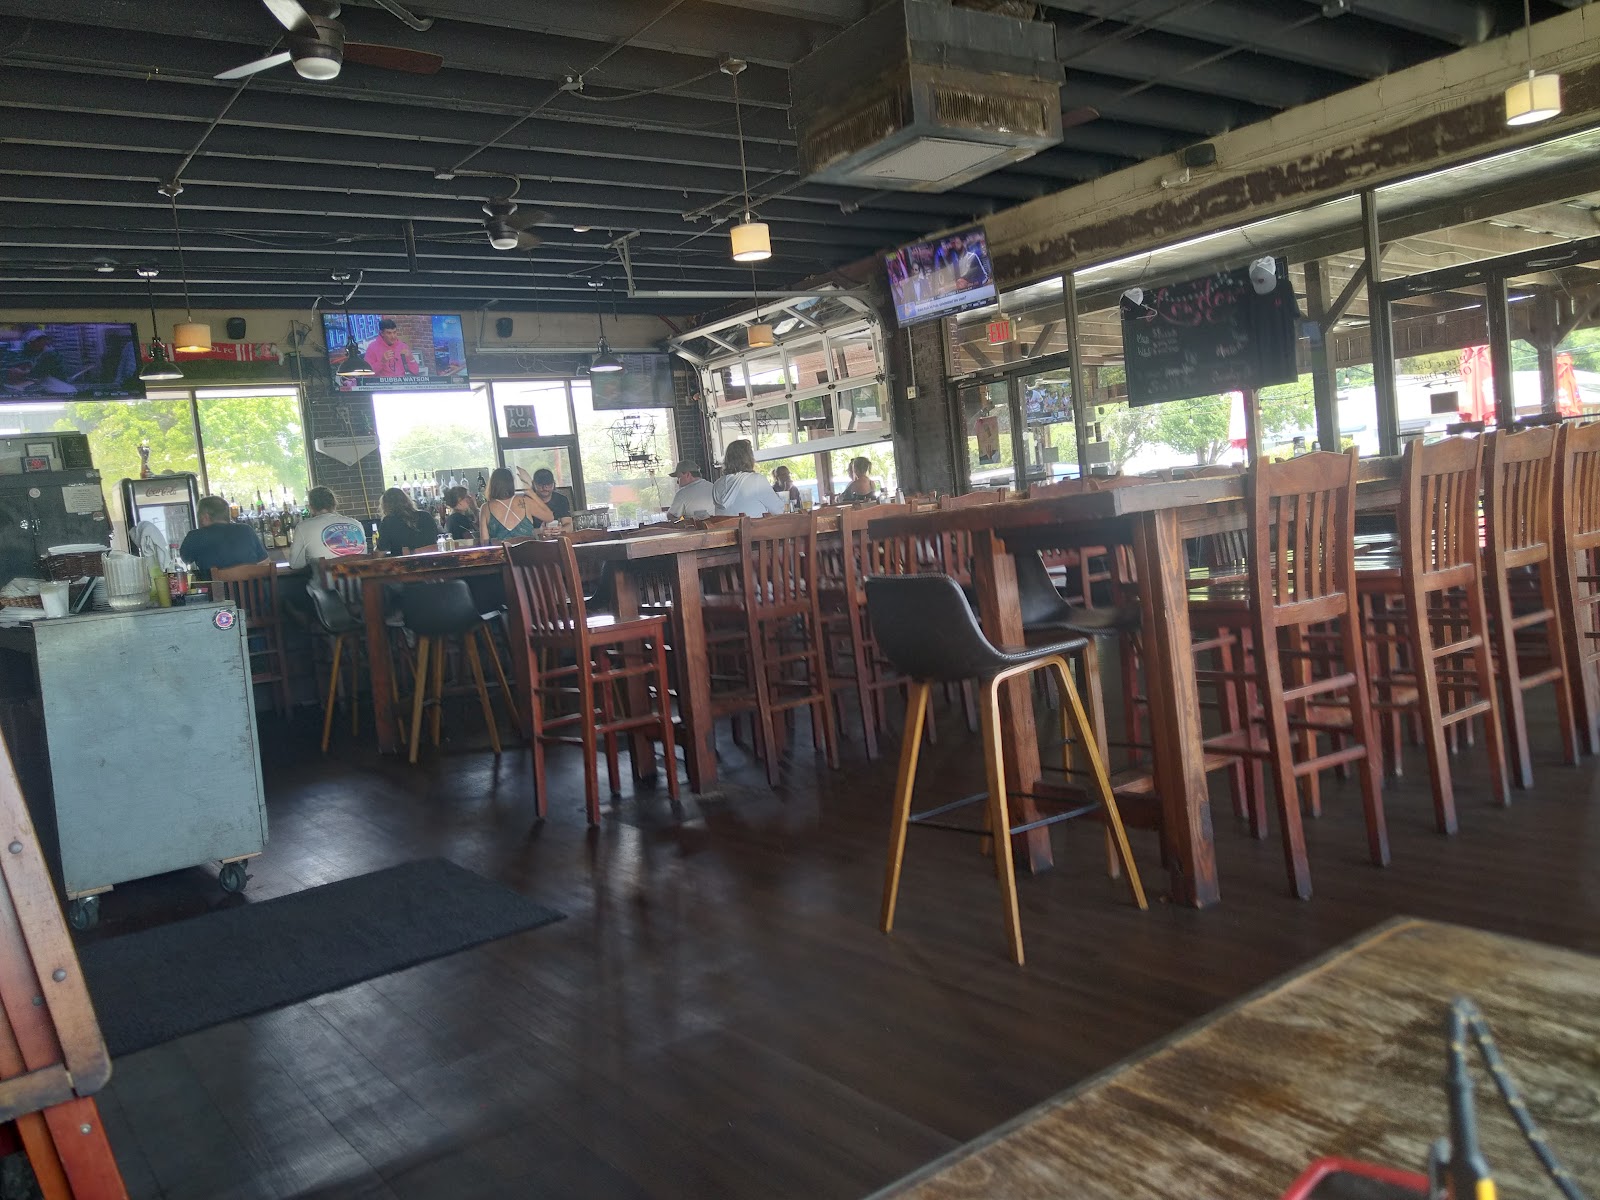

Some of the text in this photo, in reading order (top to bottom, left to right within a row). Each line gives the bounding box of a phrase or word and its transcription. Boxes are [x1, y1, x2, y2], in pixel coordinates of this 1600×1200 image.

[989, 321, 1009, 343] EXIT
[507, 408, 524, 417] TU
[509, 418, 535, 428] ACA
[145, 486, 177, 497] Coca-Cola
